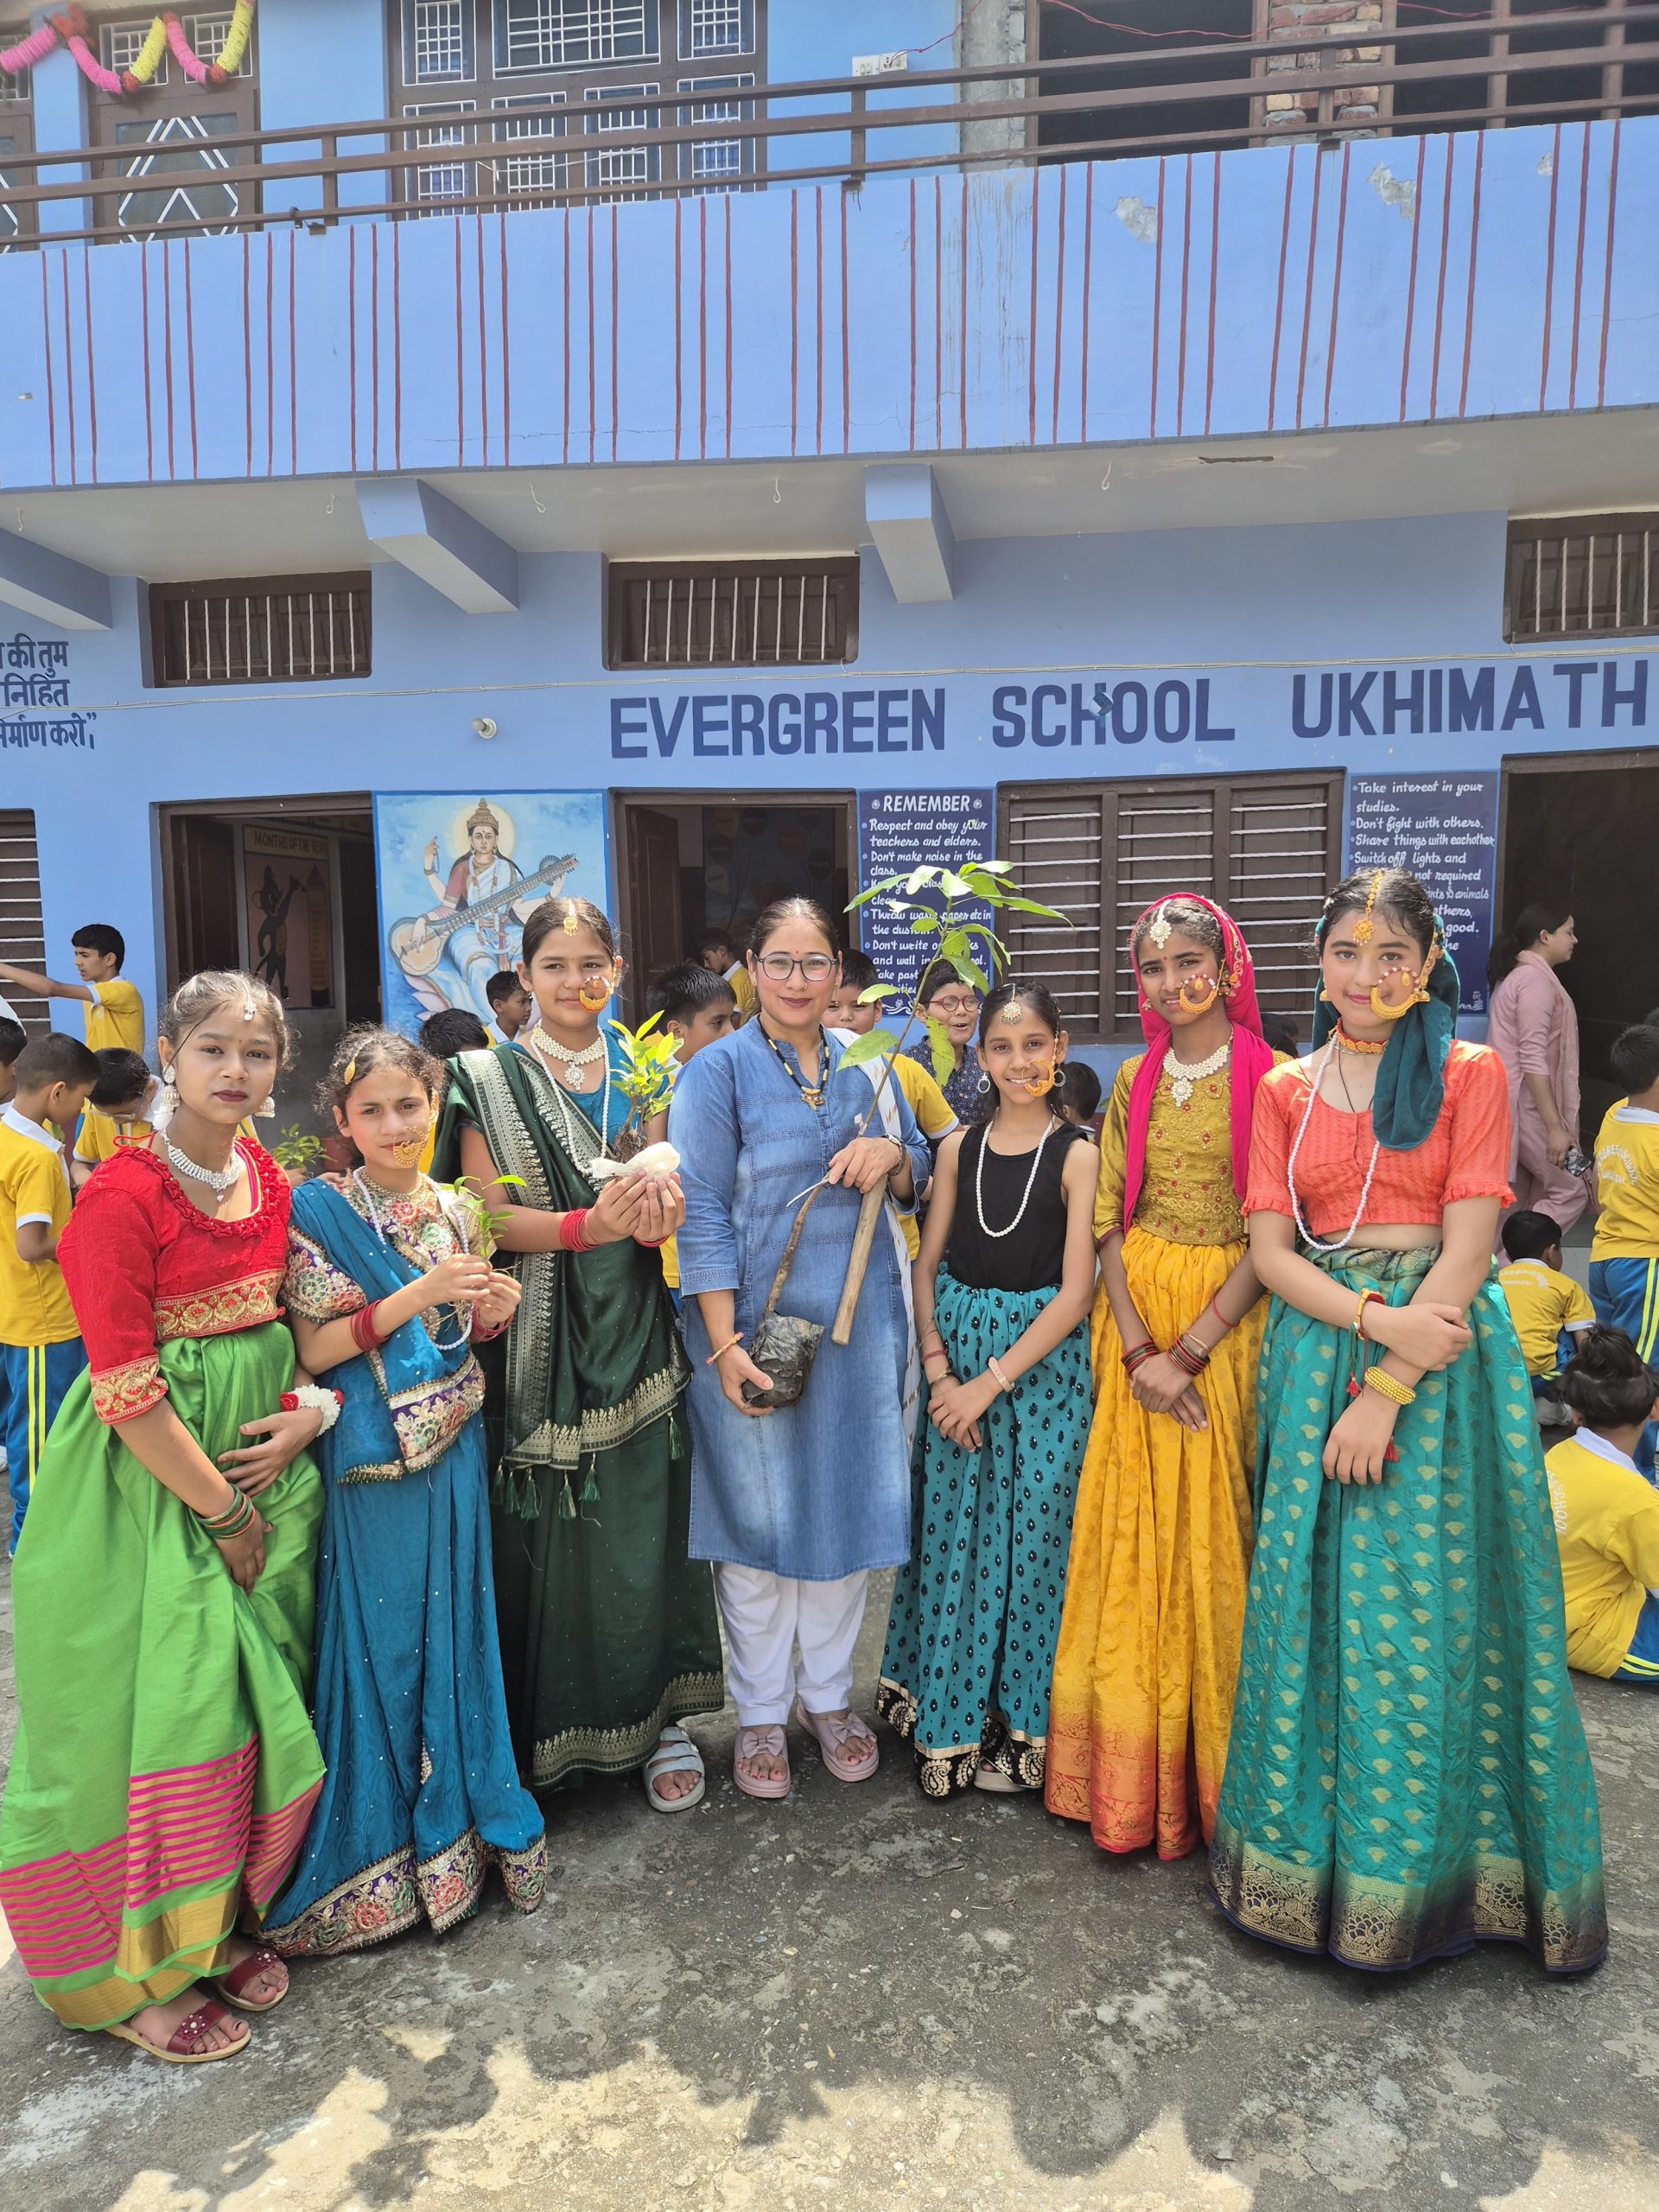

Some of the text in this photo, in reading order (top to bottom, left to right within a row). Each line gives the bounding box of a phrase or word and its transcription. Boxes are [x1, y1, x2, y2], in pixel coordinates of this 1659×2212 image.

[37, 641, 69, 678] तुम
[610, 659, 1649, 759] EVERGREEN SCHOOL UKHIMATH
[1358, 780, 1484, 797] Take interest in your
[883, 795, 970, 813] REMEMBER
[1356, 799, 1400, 812] studies.
[869, 818, 988, 835] Respect and obey your
[1356, 816, 1484, 833] Don't fight with others.
[254, 831, 288, 849] MONTHS
[869, 835, 982, 847] teachers and elders.
[1355, 833, 1389, 846] Share
[1394, 834, 1427, 850] things
[1428, 833, 1449, 846] with
[871, 849, 982, 861] Don't make noise in the
[1388, 850, 1407, 867] off
[1412, 851, 1441, 868] lights
[1445, 852, 1467, 864] and
[870, 865, 898, 876] class.
[1414, 868, 1433, 881] not
[1435, 868, 1482, 886] required
[1455, 887, 1490, 899] animals
[870, 908, 906, 920] Throw
[872, 924, 891, 935] the
[1446, 920, 1479, 938] good.
[873, 939, 898, 950] Don't
[899, 939, 928, 950] write
[873, 955, 893, 965] and
[897, 955, 915, 965] wall
[876, 969, 894, 980] ake
